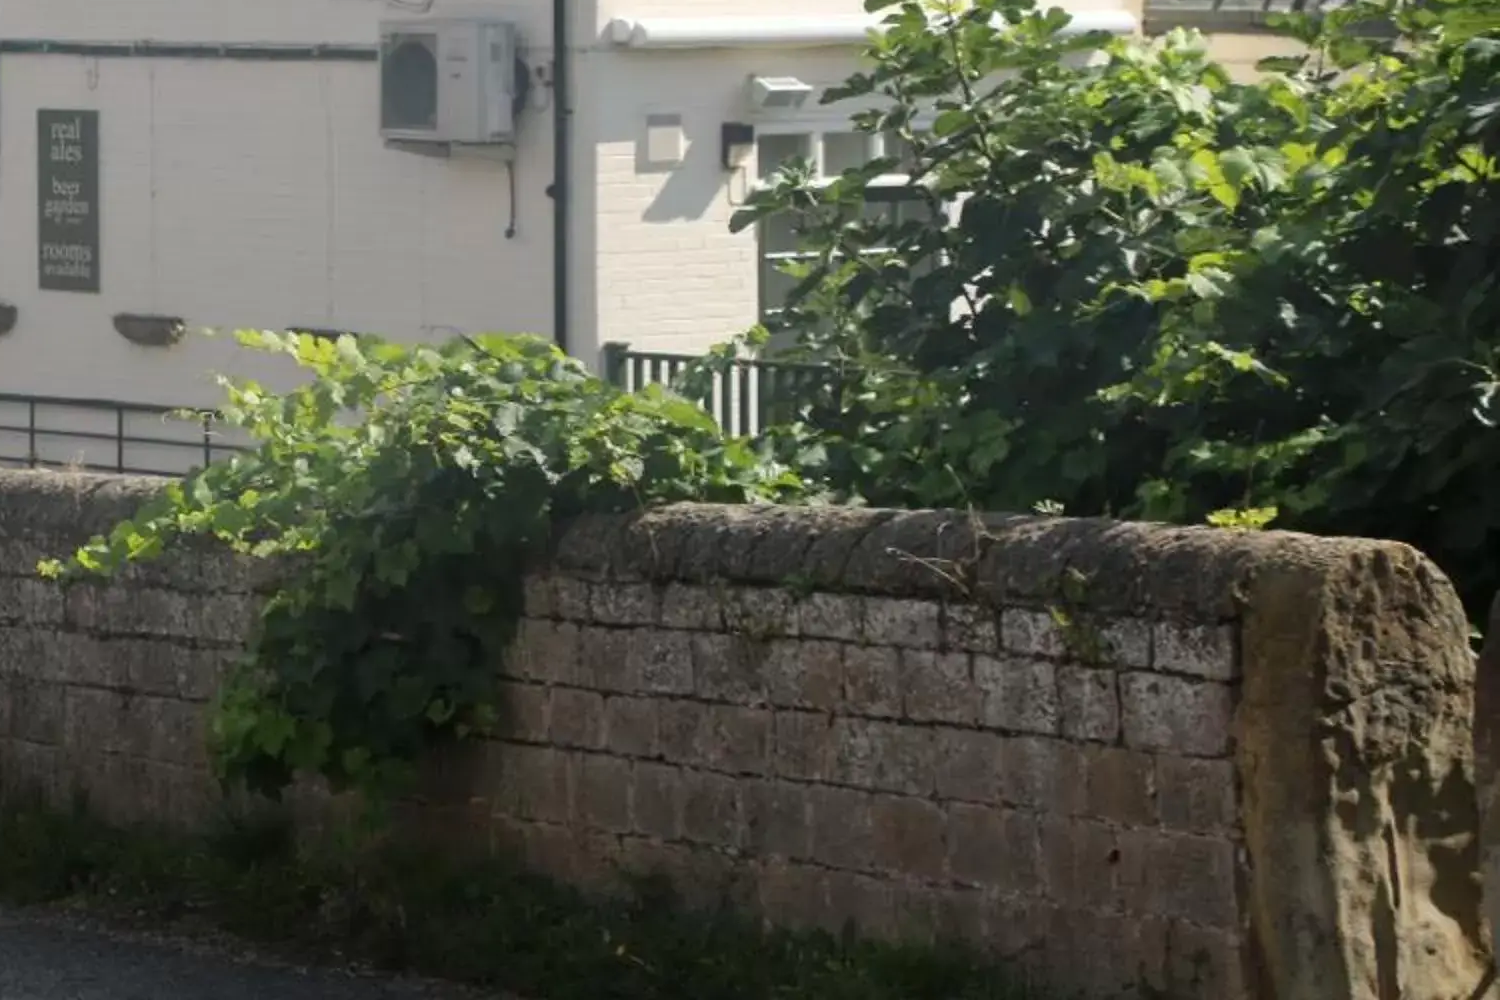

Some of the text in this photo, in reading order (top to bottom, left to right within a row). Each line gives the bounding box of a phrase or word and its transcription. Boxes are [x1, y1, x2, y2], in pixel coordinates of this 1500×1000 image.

[50, 117, 80, 140] real
[50, 139, 83, 162] ales
[52, 176, 80, 195] beer
[44, 196, 89, 218] garden
[42, 243, 92, 262] rooms
